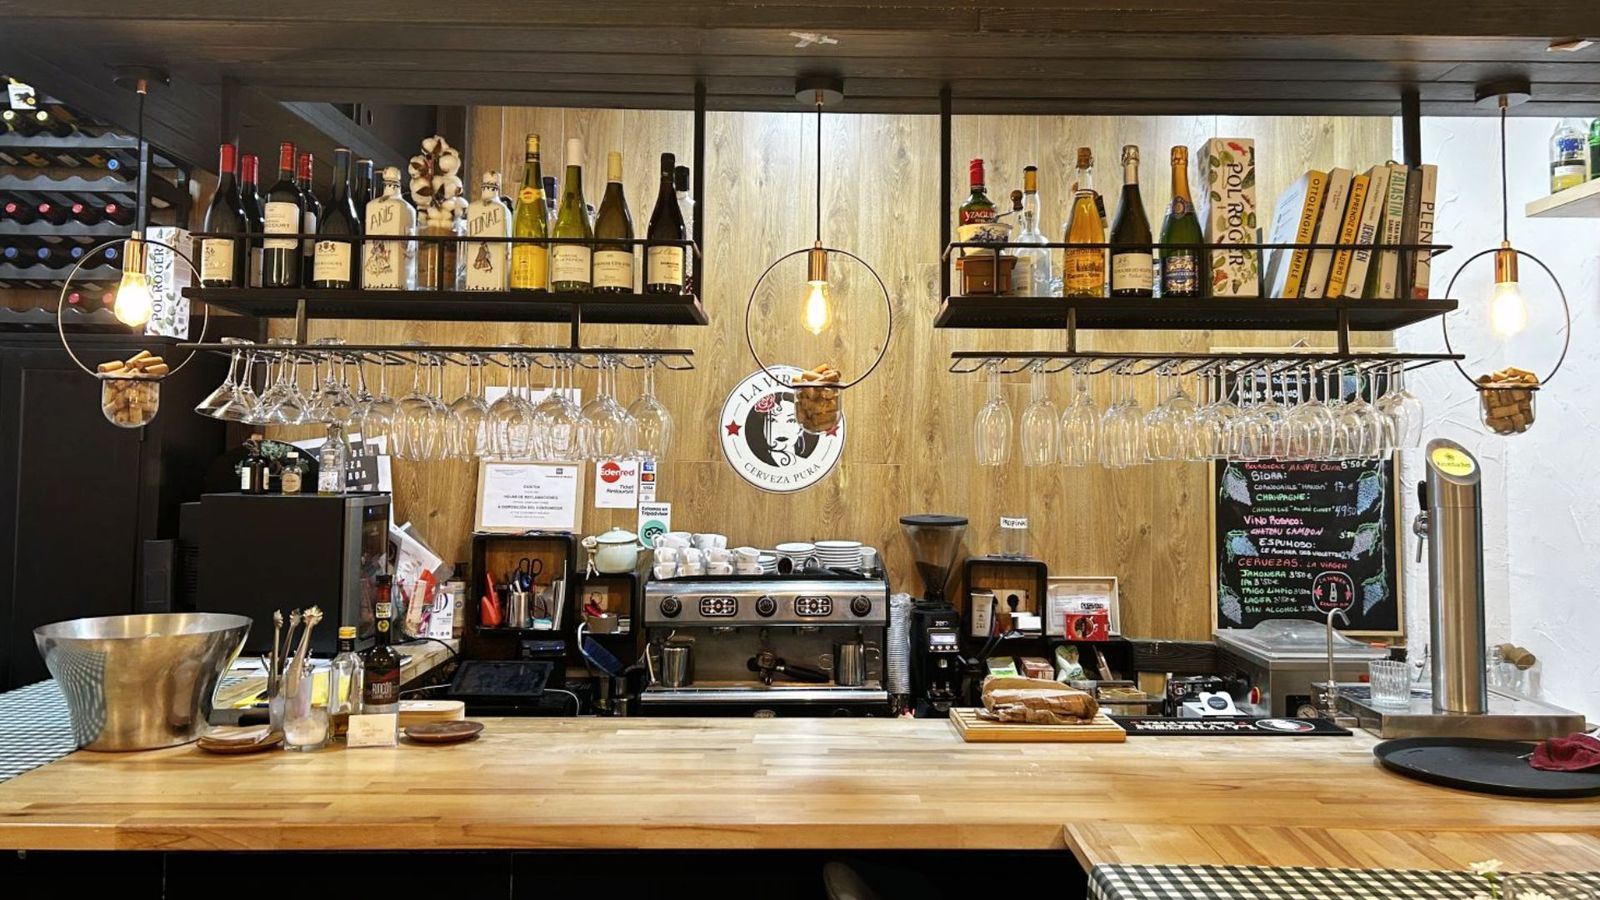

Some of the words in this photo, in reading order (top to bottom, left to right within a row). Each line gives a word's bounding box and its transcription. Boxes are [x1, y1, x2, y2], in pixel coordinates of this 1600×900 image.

[1226, 161, 1244, 199] POL
[1354, 183, 1364, 192] EL
[1388, 170, 1407, 217] FALASTIN
[1300, 178, 1321, 239] OTTOLENGHI
[1346, 192, 1361, 227] APRENDIZ
[1227, 202, 1245, 266] ROGR
[152, 248, 164, 293] ROGER
[151, 294, 163, 321] POL
[740, 383, 761, 403] LA
[762, 374, 792, 390] VIR
[600, 467, 635, 477] Edenred
[743, 462, 791, 484] CERVEZA
[793, 463, 821, 483] PURA
[1258, 537, 1317, 549] ESPUMOSO:
[1237, 556, 1303, 568] CERVEZAS:
[1239, 569, 1287, 579] JAMONERA
